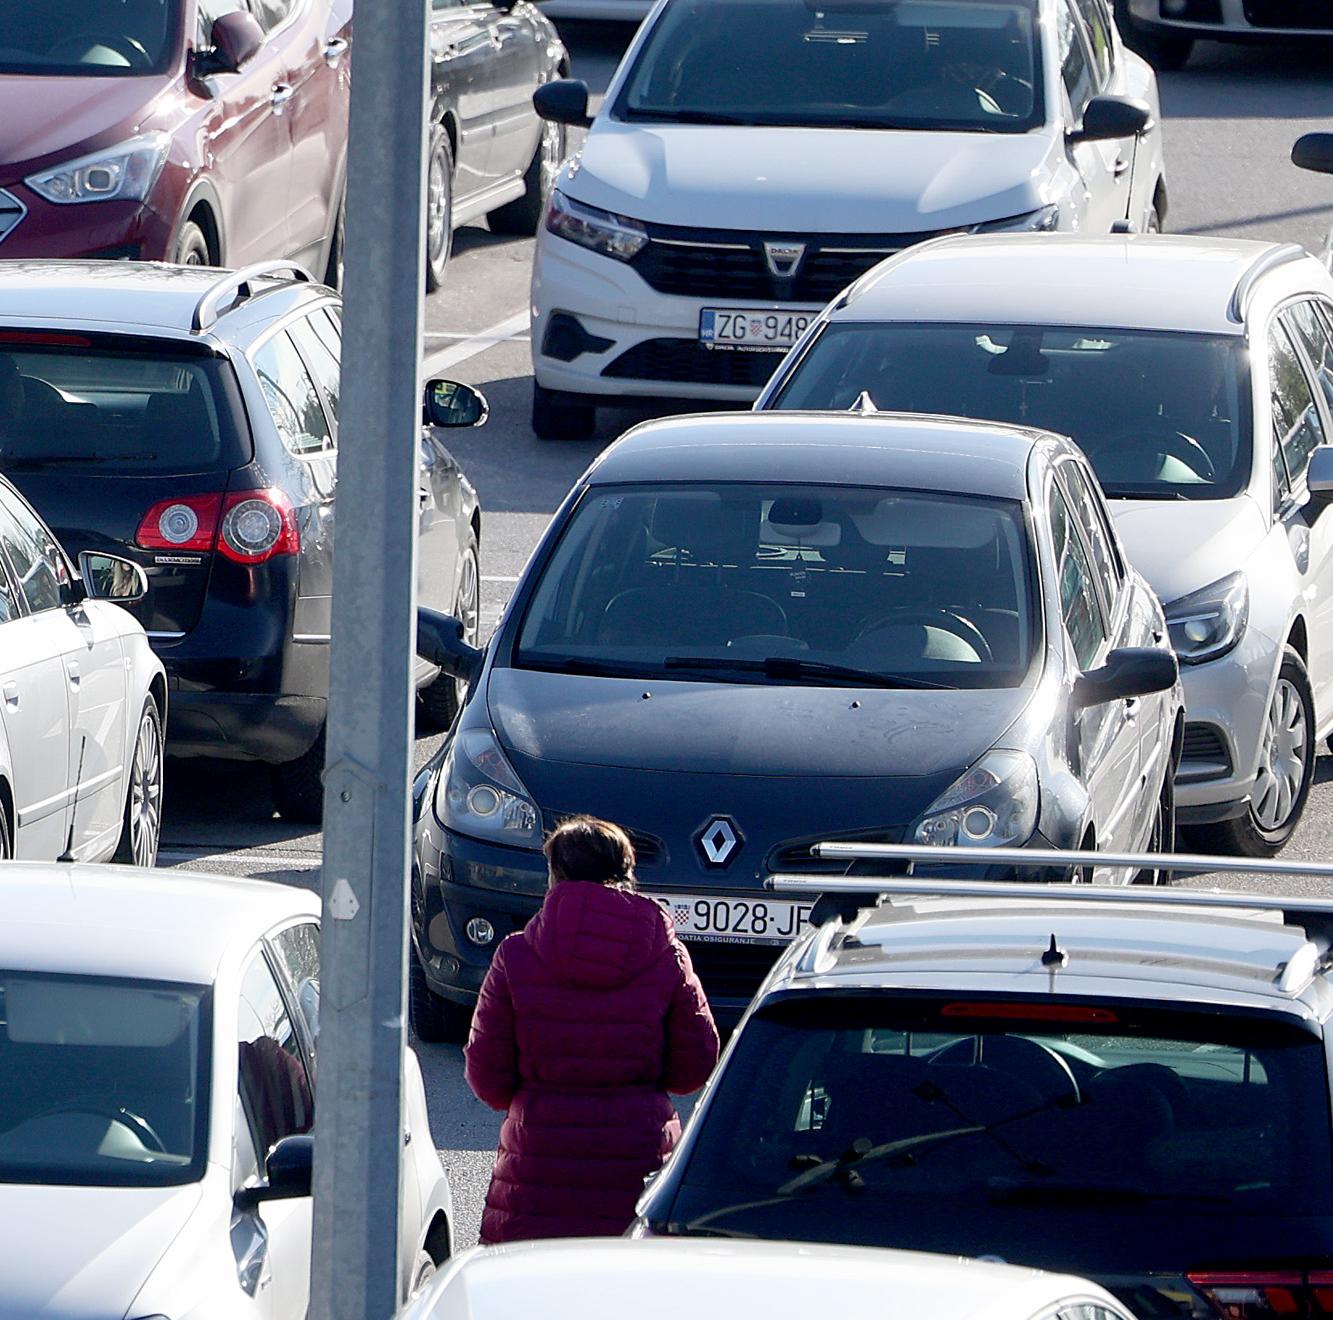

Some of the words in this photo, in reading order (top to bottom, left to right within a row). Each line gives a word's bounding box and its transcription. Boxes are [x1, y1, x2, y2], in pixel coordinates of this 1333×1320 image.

[702, 329, 714, 337] HR
[718, 314, 746, 340] ZG
[703, 936, 756, 945] OSIGURANJE
